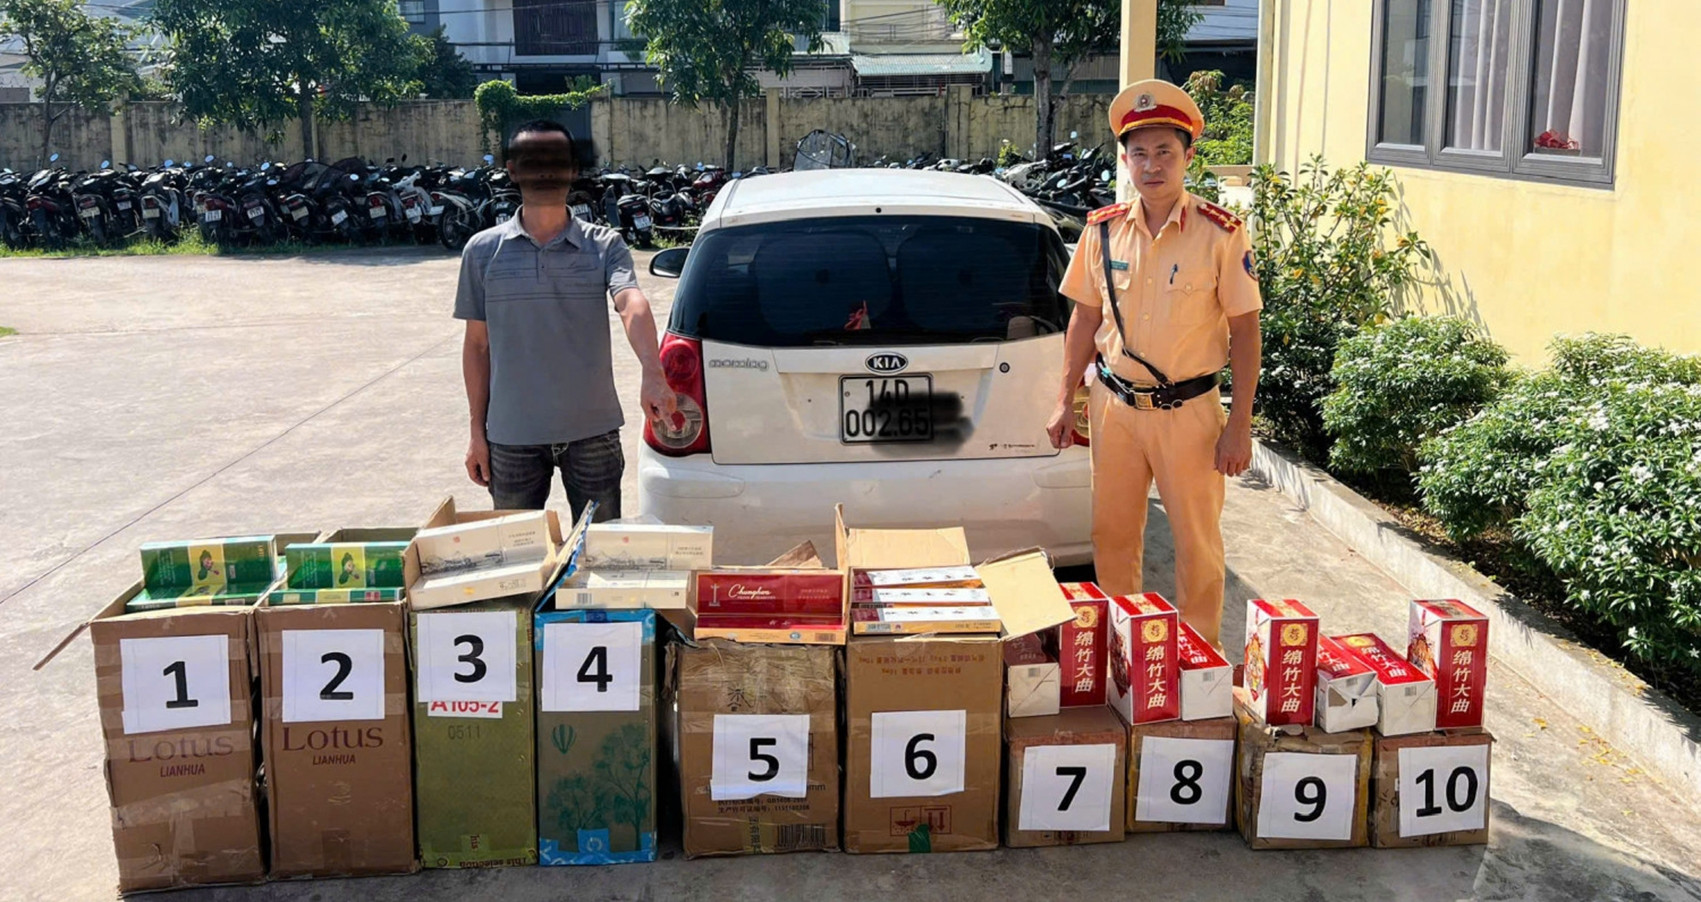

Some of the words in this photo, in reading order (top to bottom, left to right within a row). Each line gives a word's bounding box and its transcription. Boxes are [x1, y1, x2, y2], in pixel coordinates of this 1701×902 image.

[872, 356, 901, 369] KIA
[319, 651, 354, 700] 2
[453, 634, 488, 683] 3
[576, 645, 613, 693] 4
[1074, 631, 1094, 693] 绵竹大曲
[1145, 645, 1166, 709] 绵竹大曲
[1281, 650, 1303, 713] 绵竹大曲
[1451, 650, 1473, 713] 绵竹大曲
[163, 660, 199, 709] 1
[127, 734, 234, 764] Lotus
[281, 724, 384, 752] Lotus
[312, 754, 356, 766] LIANHUA
[747, 737, 780, 782] 5
[904, 733, 938, 780] 6
[160, 764, 205, 777] LIANHUA
[1055, 766, 1087, 811] 7
[1169, 759, 1203, 805] 8
[1415, 766, 1479, 818] 10
[1293, 776, 1327, 823] 9
